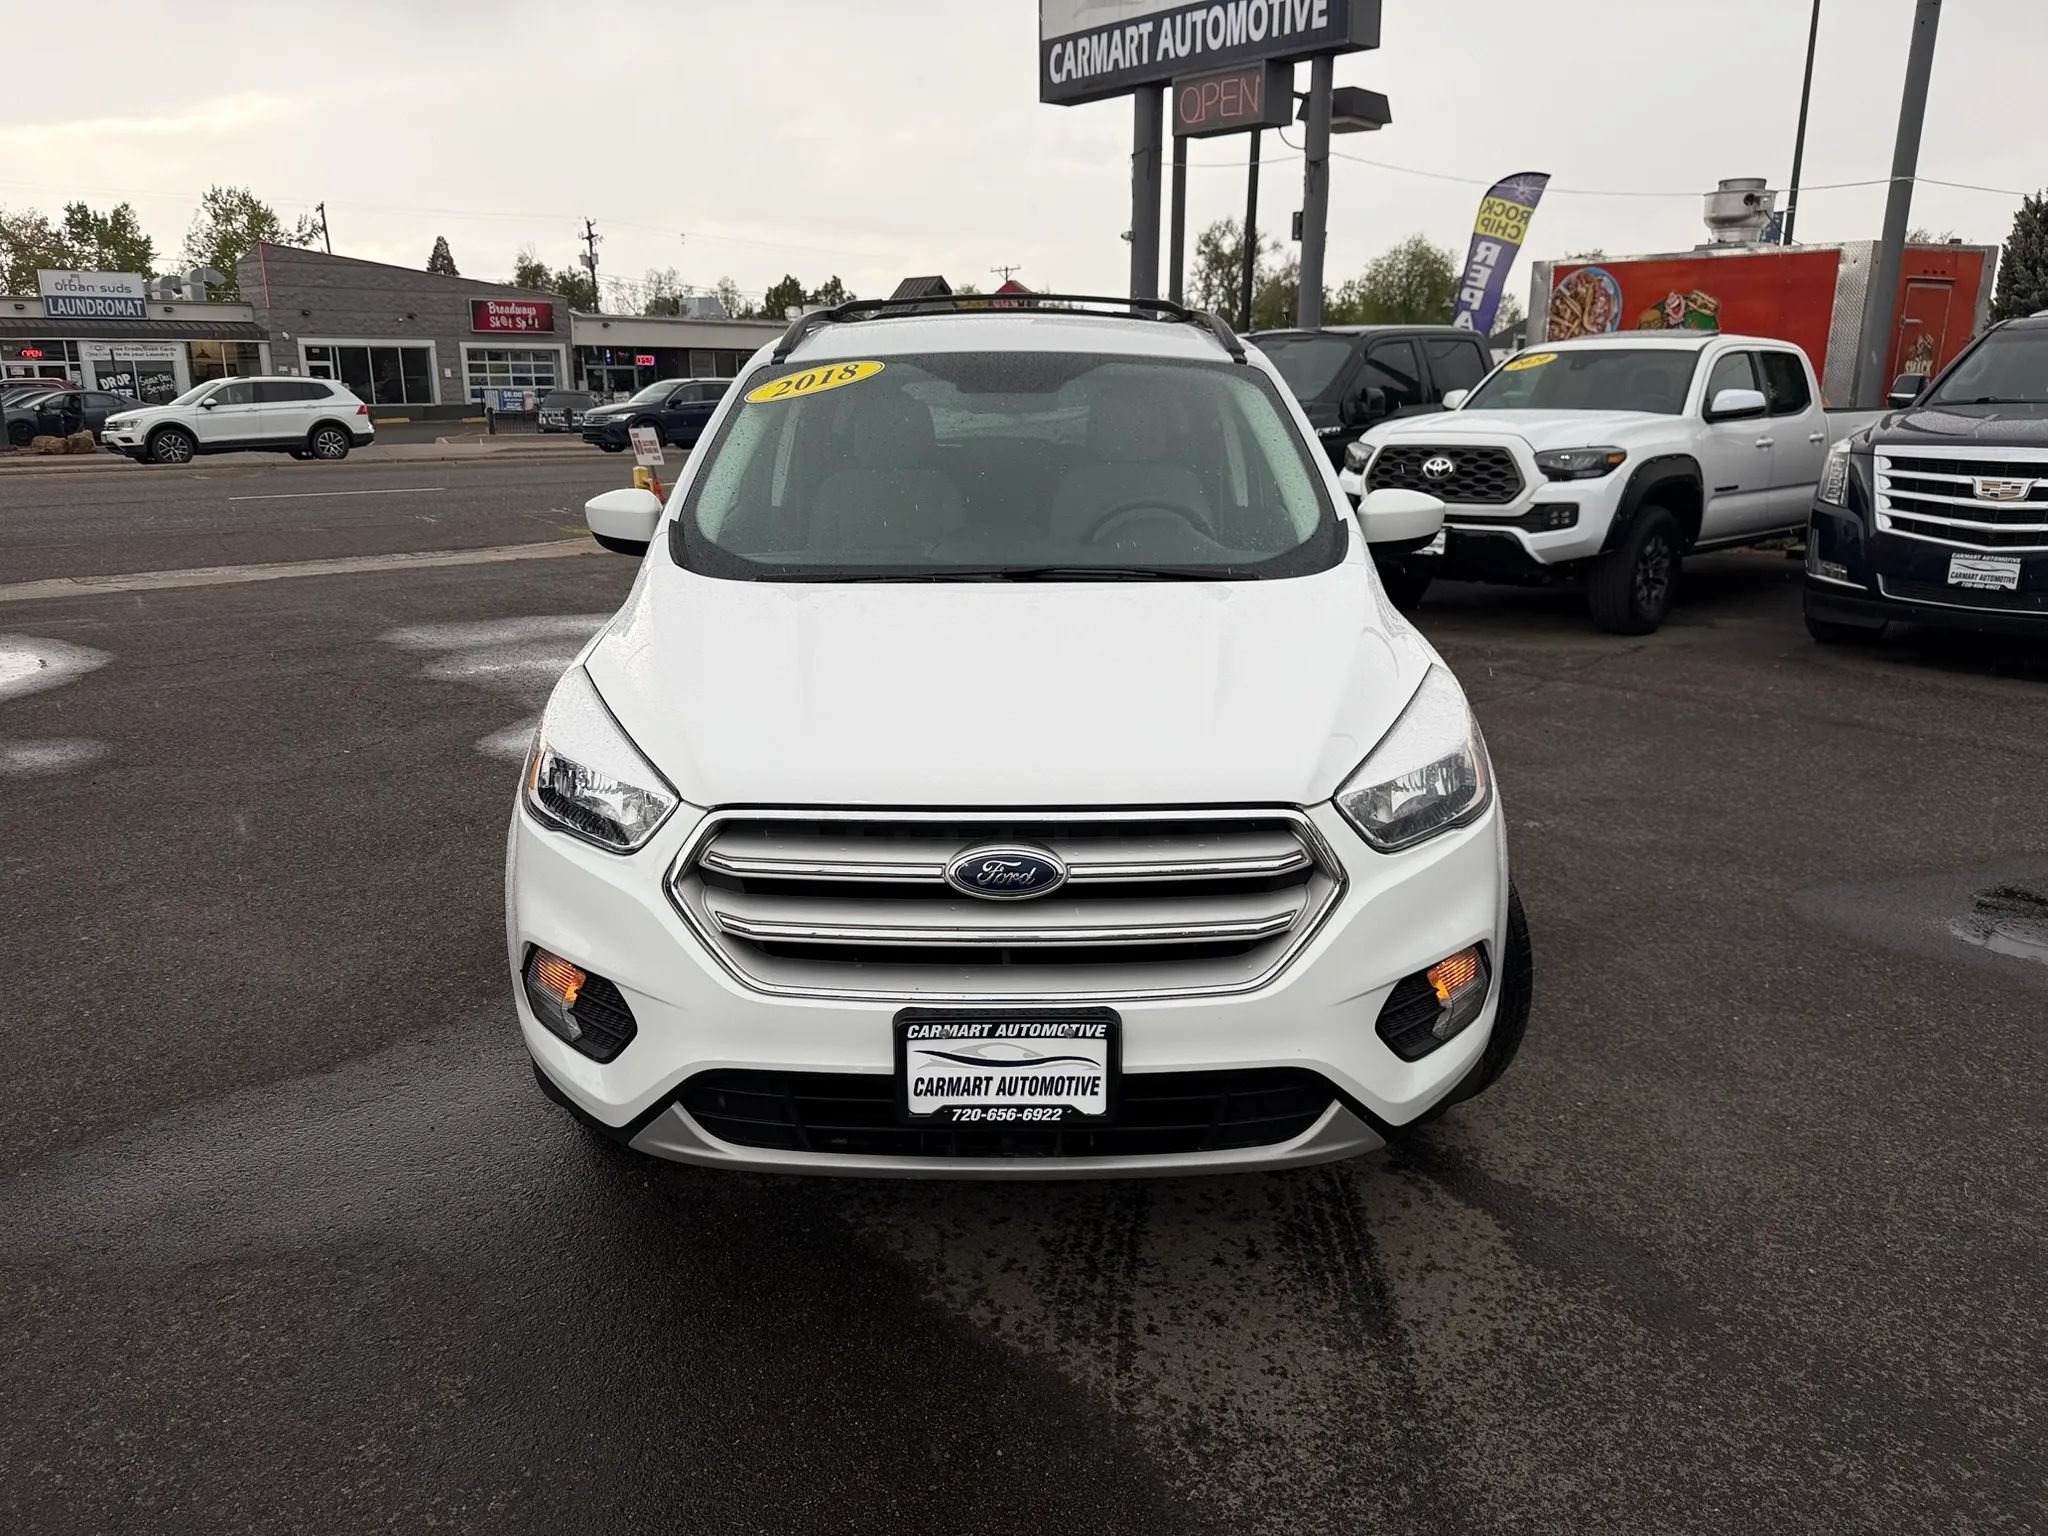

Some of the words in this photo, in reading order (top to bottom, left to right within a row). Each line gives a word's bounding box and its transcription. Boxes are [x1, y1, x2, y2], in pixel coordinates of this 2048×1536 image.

[1049, 21, 1153, 84] CARMART
[1156, 0, 1328, 62] AUTOMOTIVE
[1179, 74, 1261, 123] OPEN
[100, 284, 132, 294] suds
[48, 298, 142, 316] LAUNDROMAT
[487, 301, 537, 315] Broadways
[21, 349, 43, 358] OPEN
[99, 373, 131, 390] DROP
[771, 364, 859, 398] 2018
[1950, 571, 1978, 580] CARMART
[1979, 574, 2016, 584] AUTOMOTIVE
[976, 860, 1037, 885] Ford
[907, 1024, 992, 1039] CARMART
[995, 1023, 1107, 1038] AUTOMOTIVE
[913, 1076, 993, 1097] CARMART
[995, 1075, 1101, 1097] AUTOMOTIVE
[951, 1108, 1062, 1122] 720-656-6922
